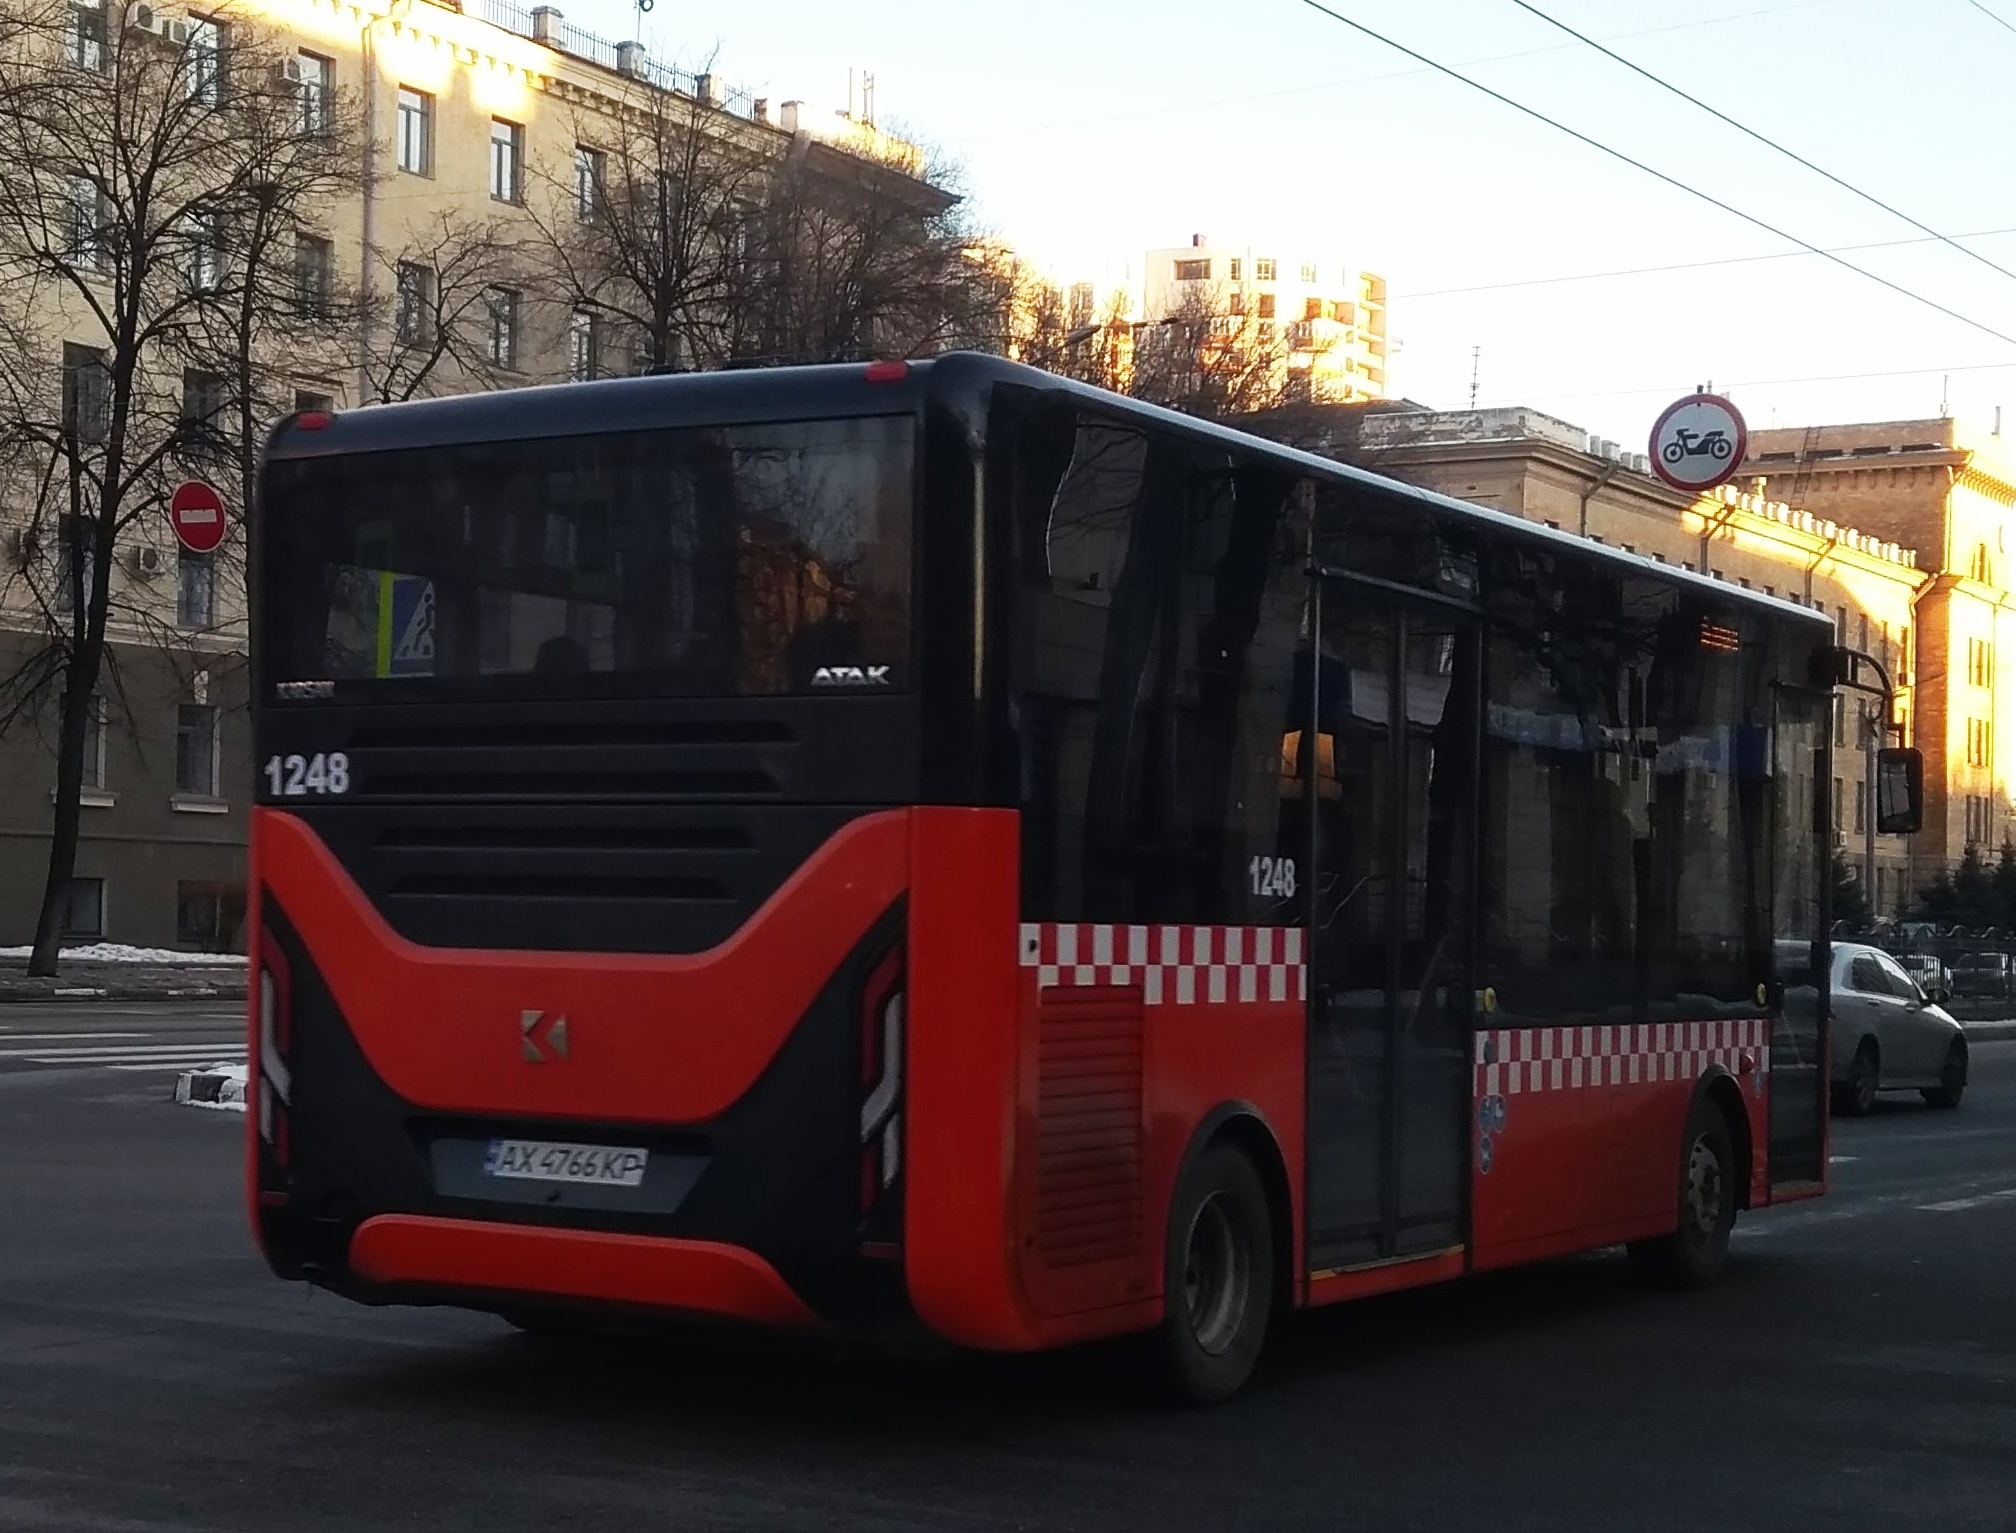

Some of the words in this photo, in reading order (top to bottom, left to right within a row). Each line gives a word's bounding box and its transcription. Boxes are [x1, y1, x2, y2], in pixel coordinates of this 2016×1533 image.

[810, 665, 890, 686] ATAK
[264, 751, 350, 796] 1248
[1249, 855, 1297, 898] 1248
